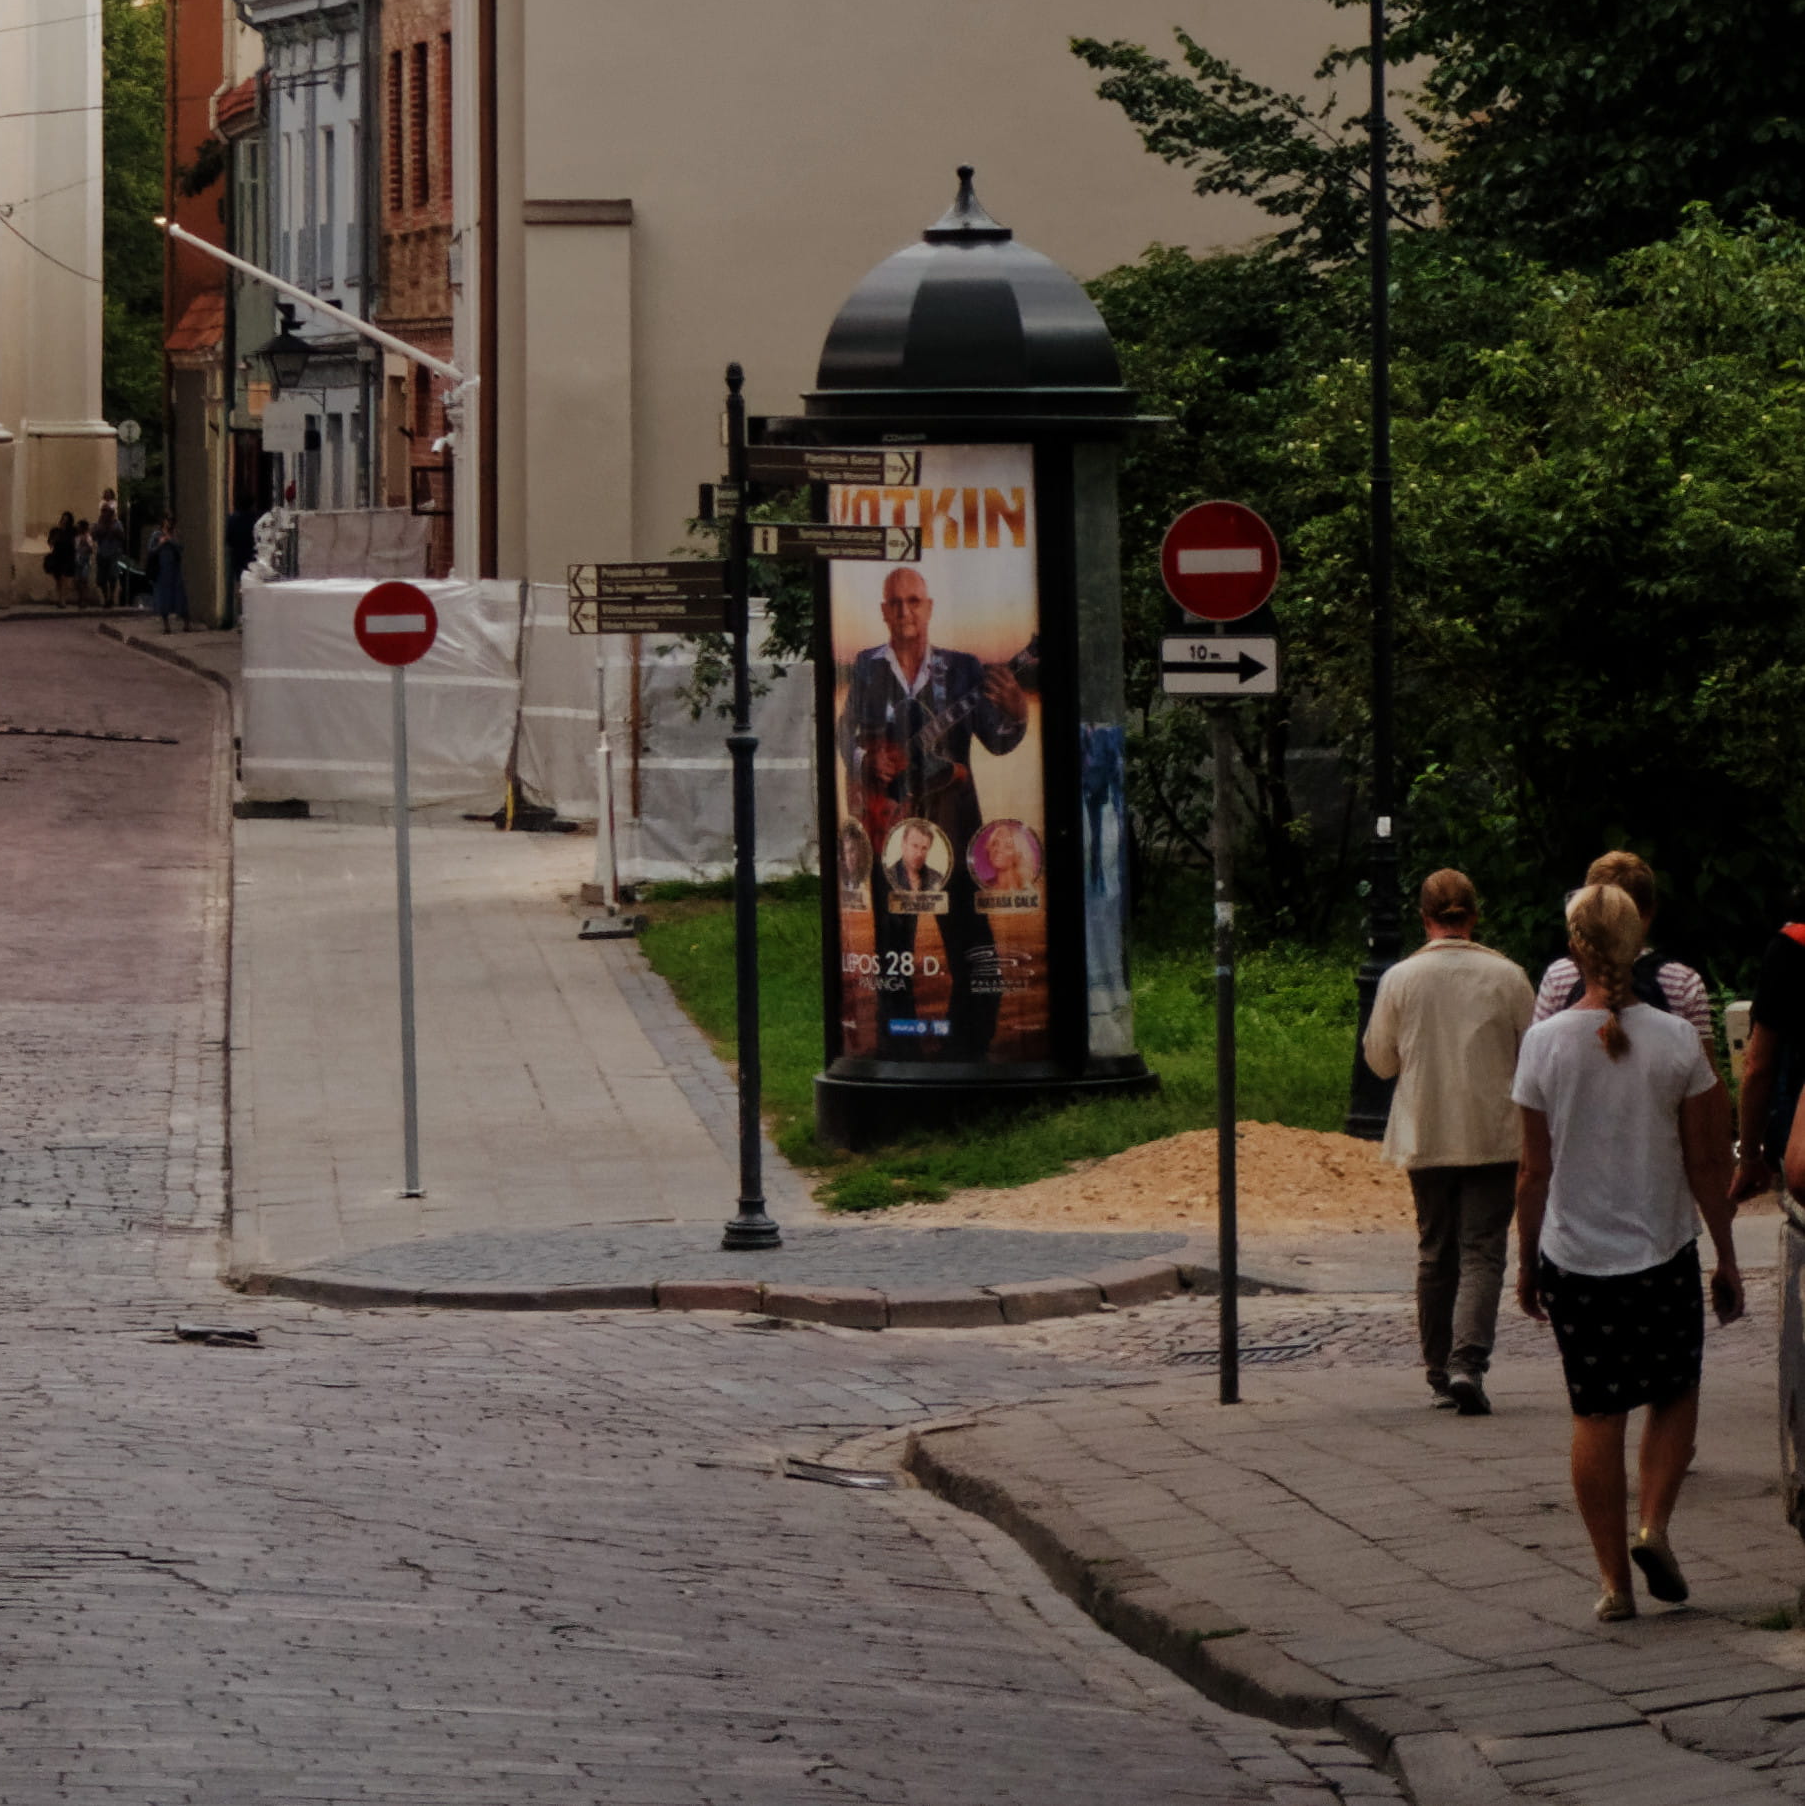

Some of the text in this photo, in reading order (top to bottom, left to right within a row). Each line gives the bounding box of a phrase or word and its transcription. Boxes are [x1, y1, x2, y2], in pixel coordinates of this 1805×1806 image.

[1189, 644, 1208, 660] 10
[885, 950, 916, 976] 28
[923, 955, 945, 976] D.
